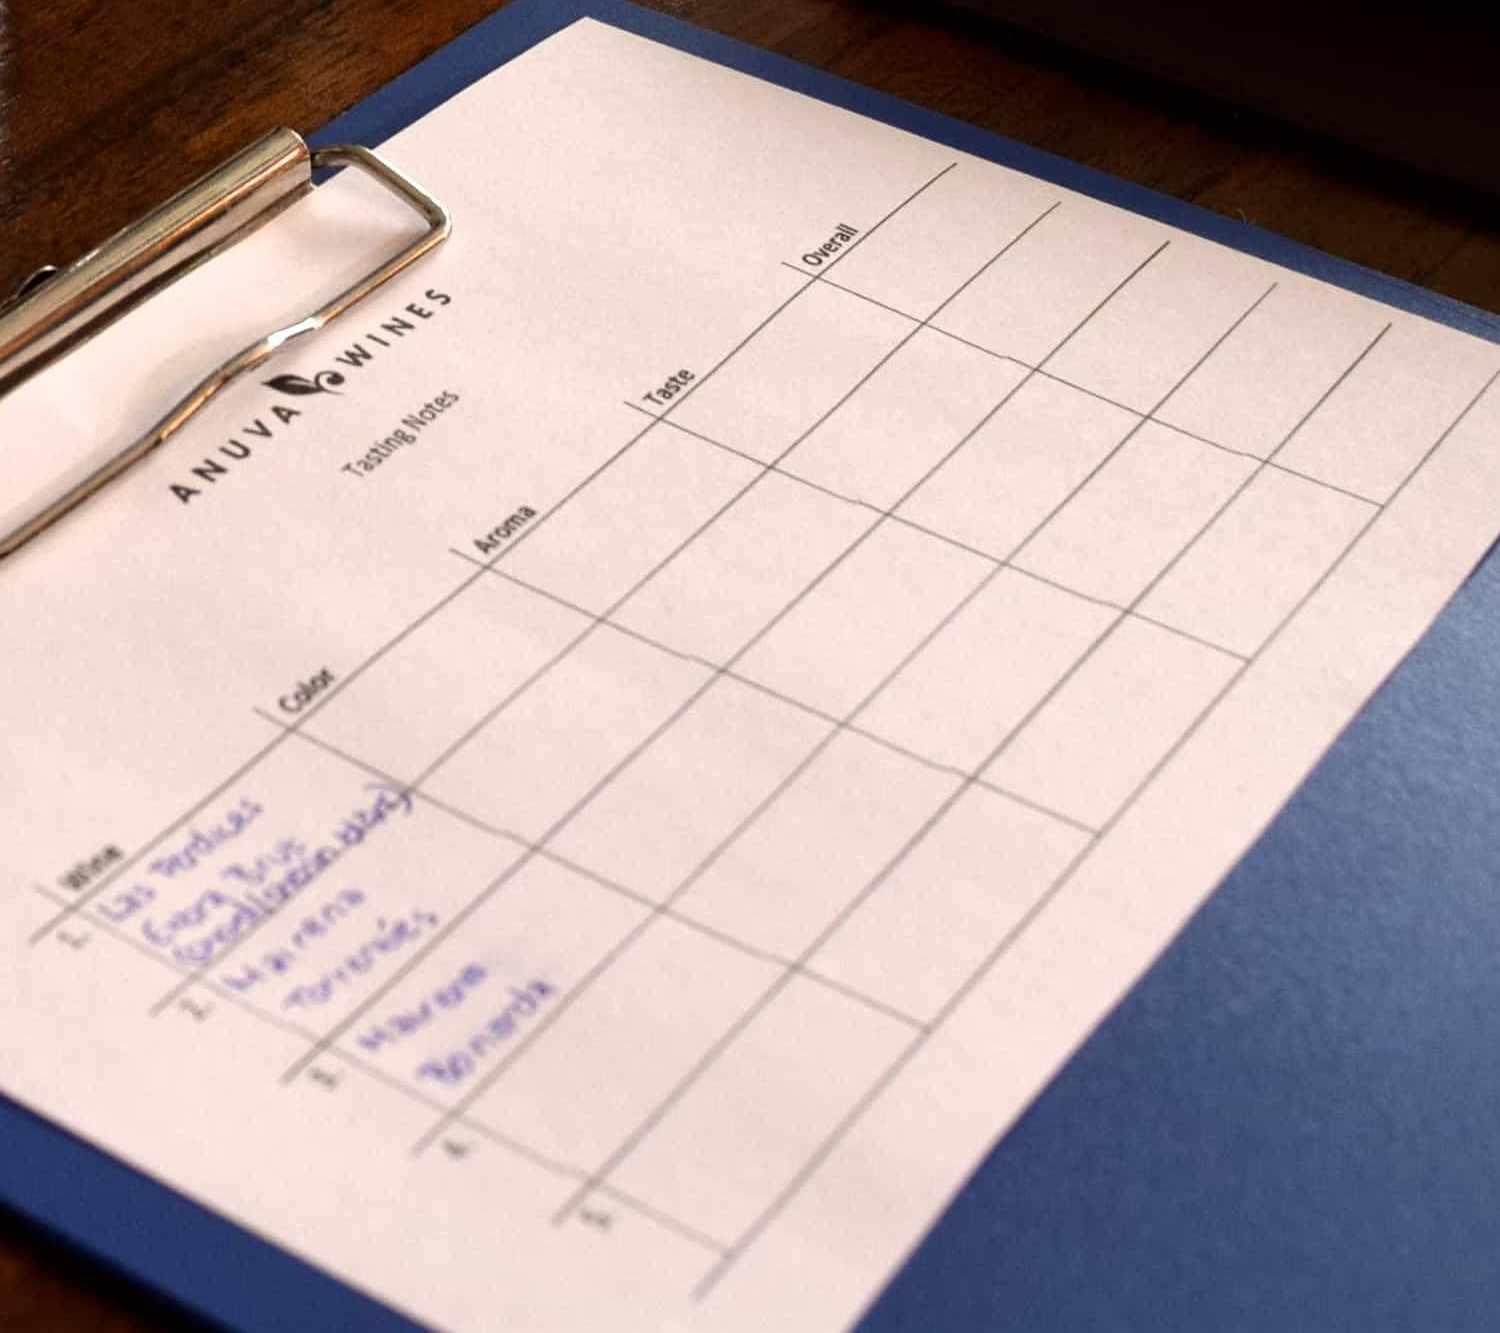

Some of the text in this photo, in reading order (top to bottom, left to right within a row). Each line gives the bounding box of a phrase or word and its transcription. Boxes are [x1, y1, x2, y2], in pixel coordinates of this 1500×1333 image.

[801, 222, 859, 266] Overall
[169, 288, 451, 504] ANUVA WINES
[641, 369, 696, 405] Taste
[341, 389, 460, 479] Tasting Notes
[473, 505, 537, 554] Aroma
[277, 666, 335, 713] Color
[57, 843, 124, 889] Wine
